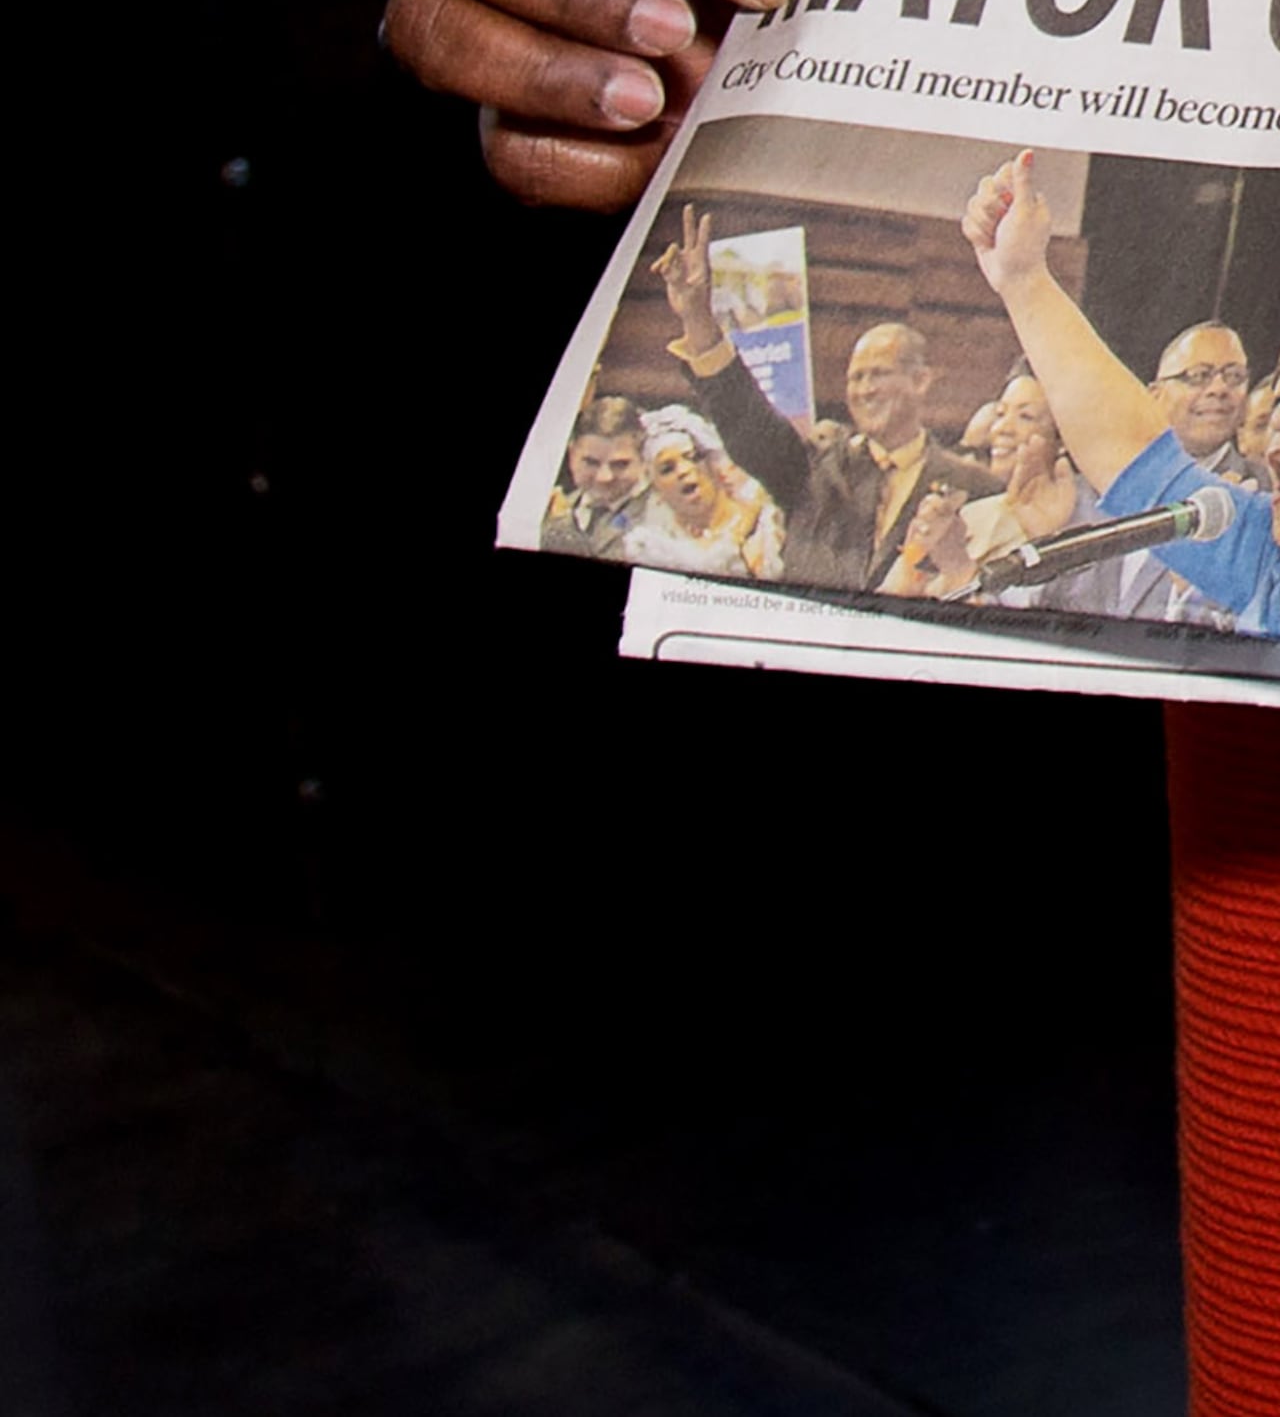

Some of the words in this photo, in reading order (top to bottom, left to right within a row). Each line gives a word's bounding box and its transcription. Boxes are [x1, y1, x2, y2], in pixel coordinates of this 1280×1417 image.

[721, 56, 774, 91] City
[774, 50, 911, 91] Council
[914, 69, 1071, 112] member
[1080, 82, 1150, 120] will
[712, 593, 760, 610] would
[763, 595, 782, 612] be
